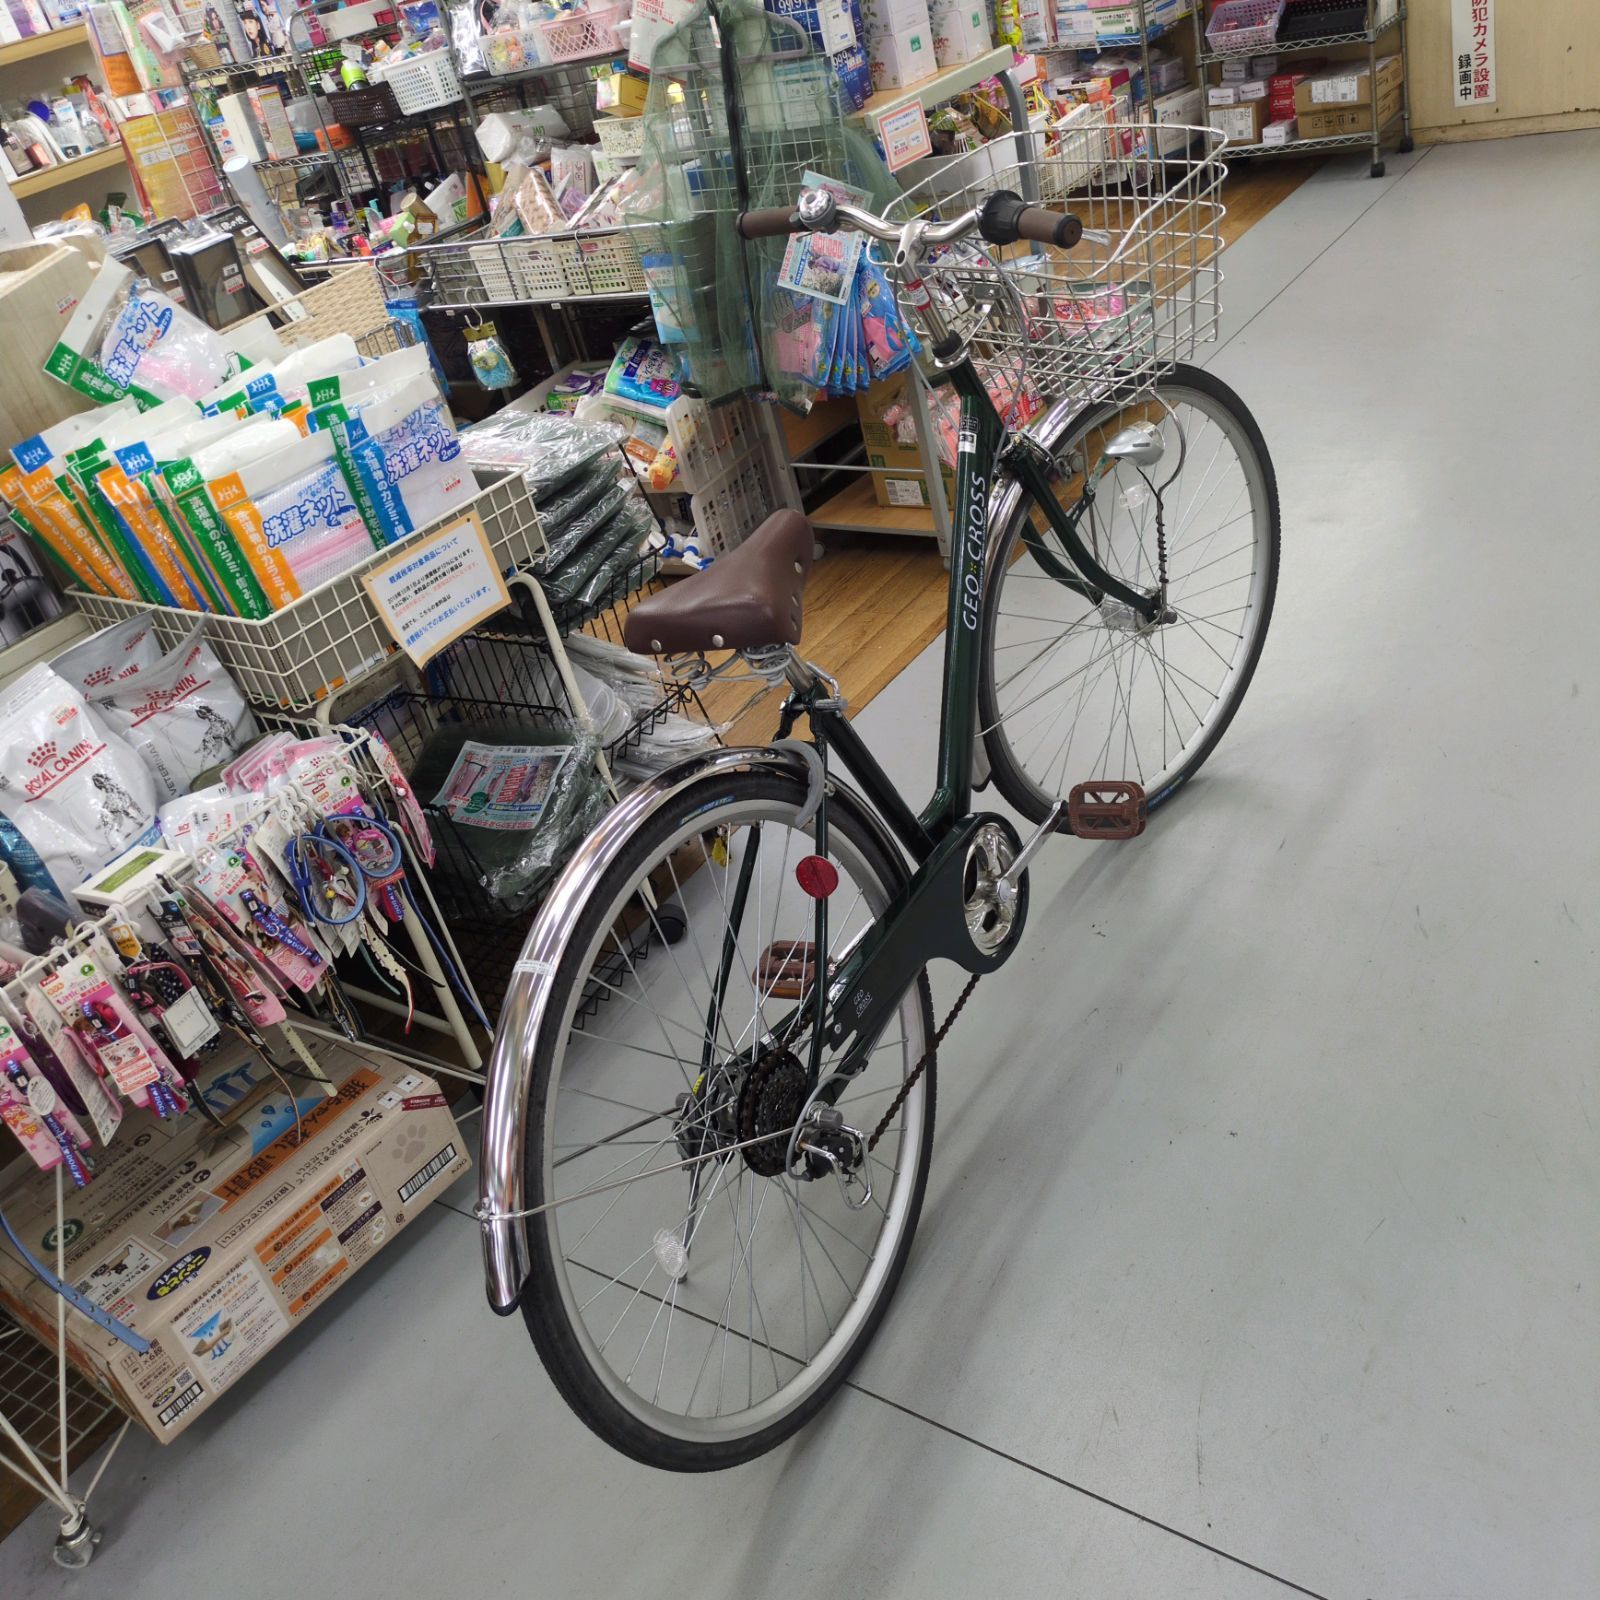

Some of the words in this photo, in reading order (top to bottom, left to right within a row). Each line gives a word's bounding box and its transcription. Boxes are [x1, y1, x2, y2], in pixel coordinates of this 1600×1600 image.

[1457, 53, 1472, 101] 録画中
[385, 427, 451, 487] 洗濯ネット
[263, 487, 346, 548] 洗濯ネット
[967, 471, 985, 562] CROSS
[963, 573, 979, 631] GEO
[24, 770, 56, 795] ROYAL
[55, 740, 94, 773] CANIN
[220, 1185, 289, 1247] 投げないでください
[155, 1253, 206, 1298] ニャンとも
